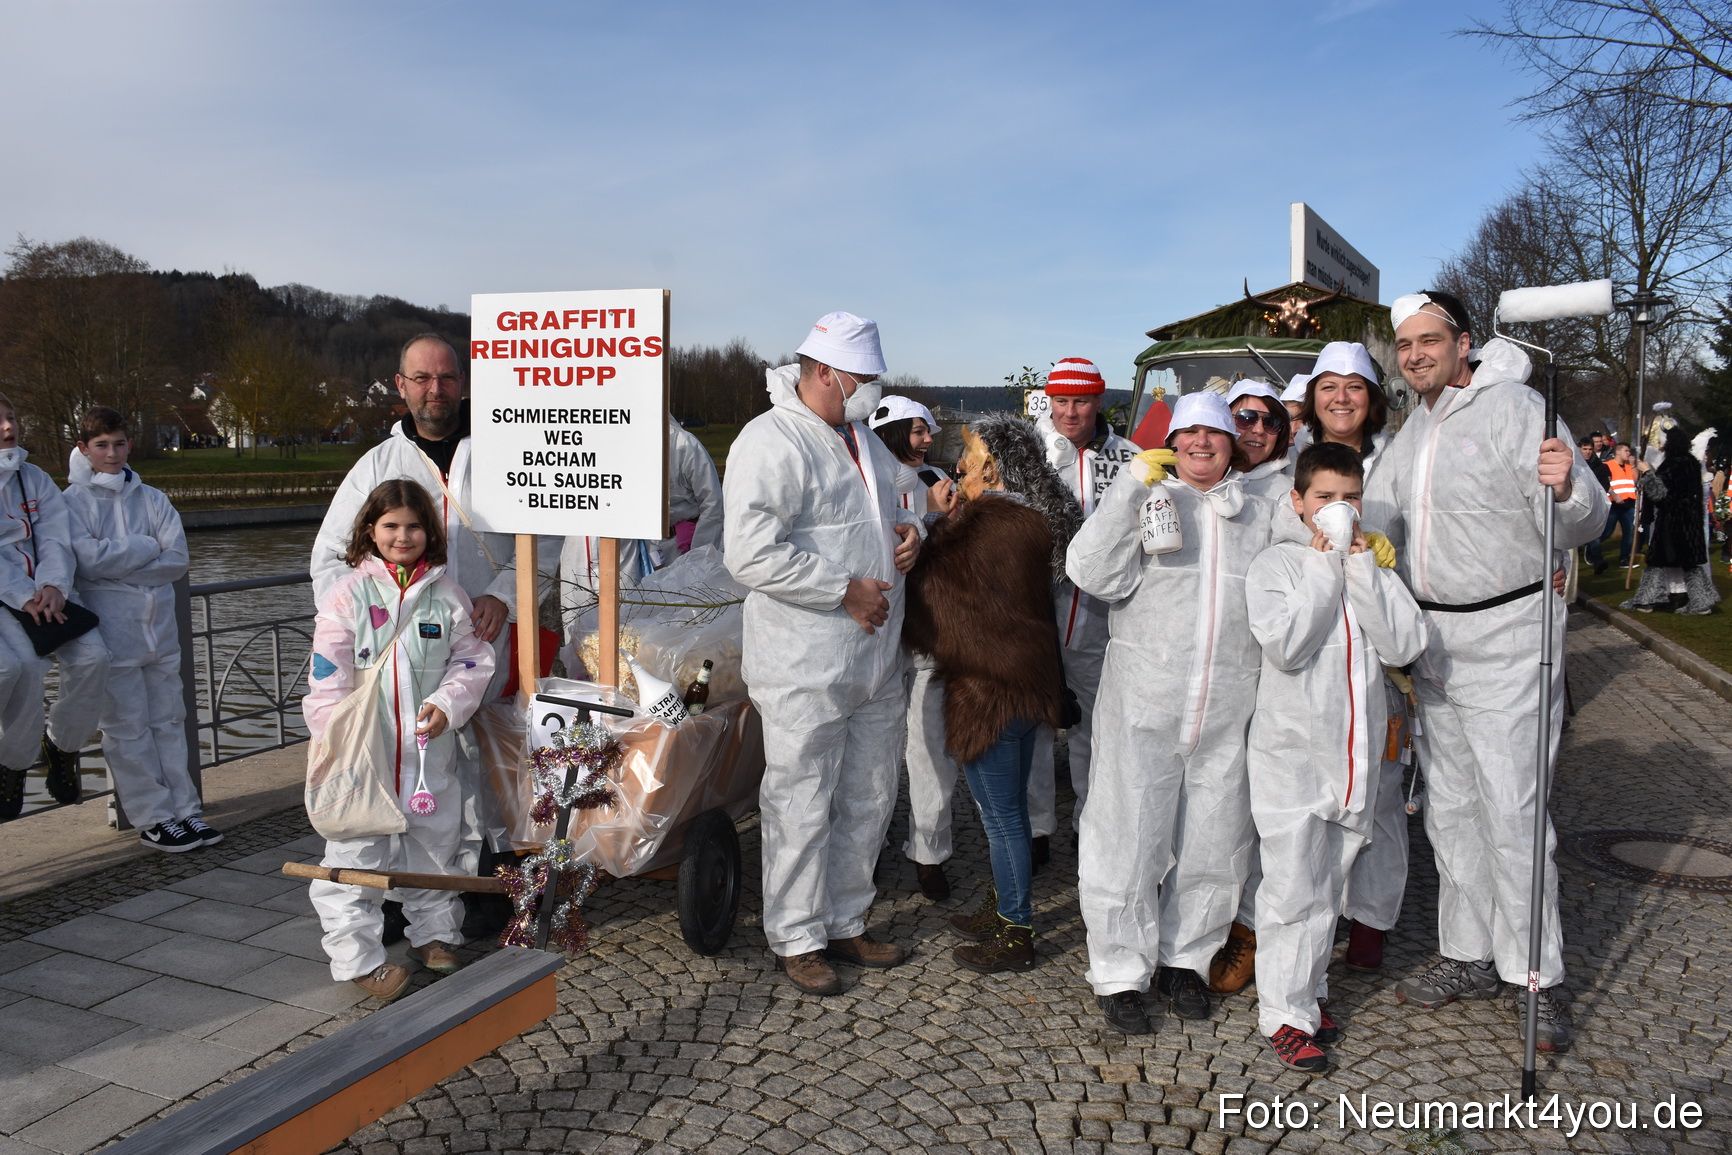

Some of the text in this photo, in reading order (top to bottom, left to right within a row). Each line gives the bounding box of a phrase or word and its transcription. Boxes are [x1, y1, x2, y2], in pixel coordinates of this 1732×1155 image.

[497, 309, 635, 331] GRAFFITI
[471, 336, 662, 359] REINIGUNGS
[513, 366, 616, 386] TRUPP
[1030, 396, 1048, 411] 35
[492, 408, 631, 424] SCHMIEREREIEN
[544, 430, 583, 446] WEG
[523, 451, 596, 467] BACHAM
[506, 472, 622, 489] SOLL SAUBER
[528, 494, 599, 510] BLEIBEN
[649, 692, 676, 715] ULTRA
